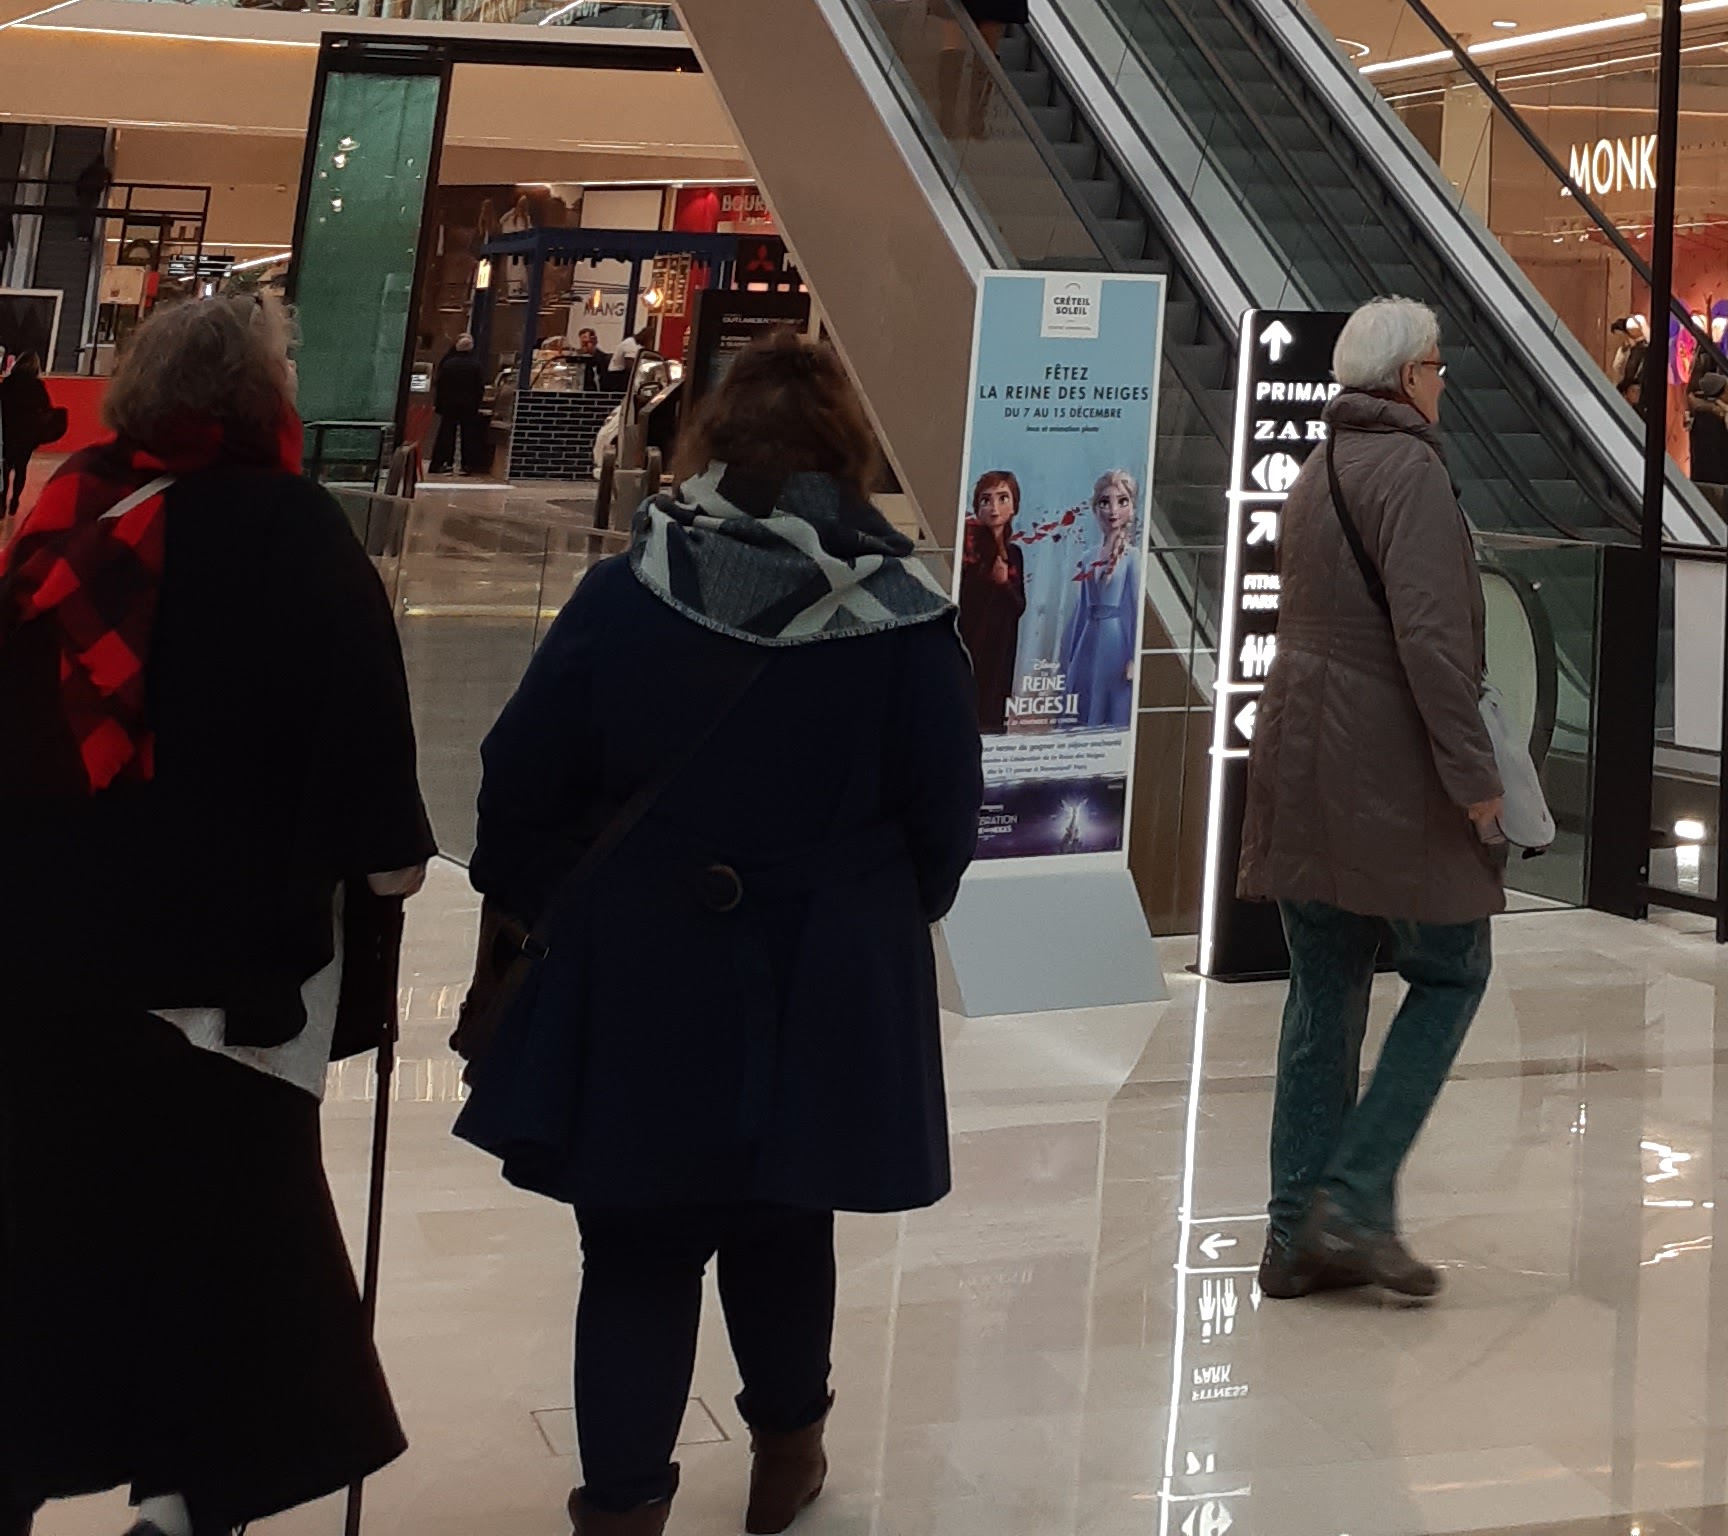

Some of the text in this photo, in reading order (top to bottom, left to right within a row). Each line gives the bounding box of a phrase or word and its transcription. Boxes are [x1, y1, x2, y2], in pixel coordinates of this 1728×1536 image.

[722, 194, 769, 212] BOUR
[1053, 295, 1091, 306] CRÉTEIL
[1055, 306, 1088, 316] SOLEIL
[1045, 363, 1089, 381] FÊTEZ
[979, 385, 1149, 401] LA REINE DES NEIGES
[1004, 405, 1122, 418] DU 7 AU 15 DÉCEMBRE
[1242, 594, 1280, 610] PARK
[1022, 675, 1066, 692] REINE
[1005, 696, 1064, 717] NEIGES
